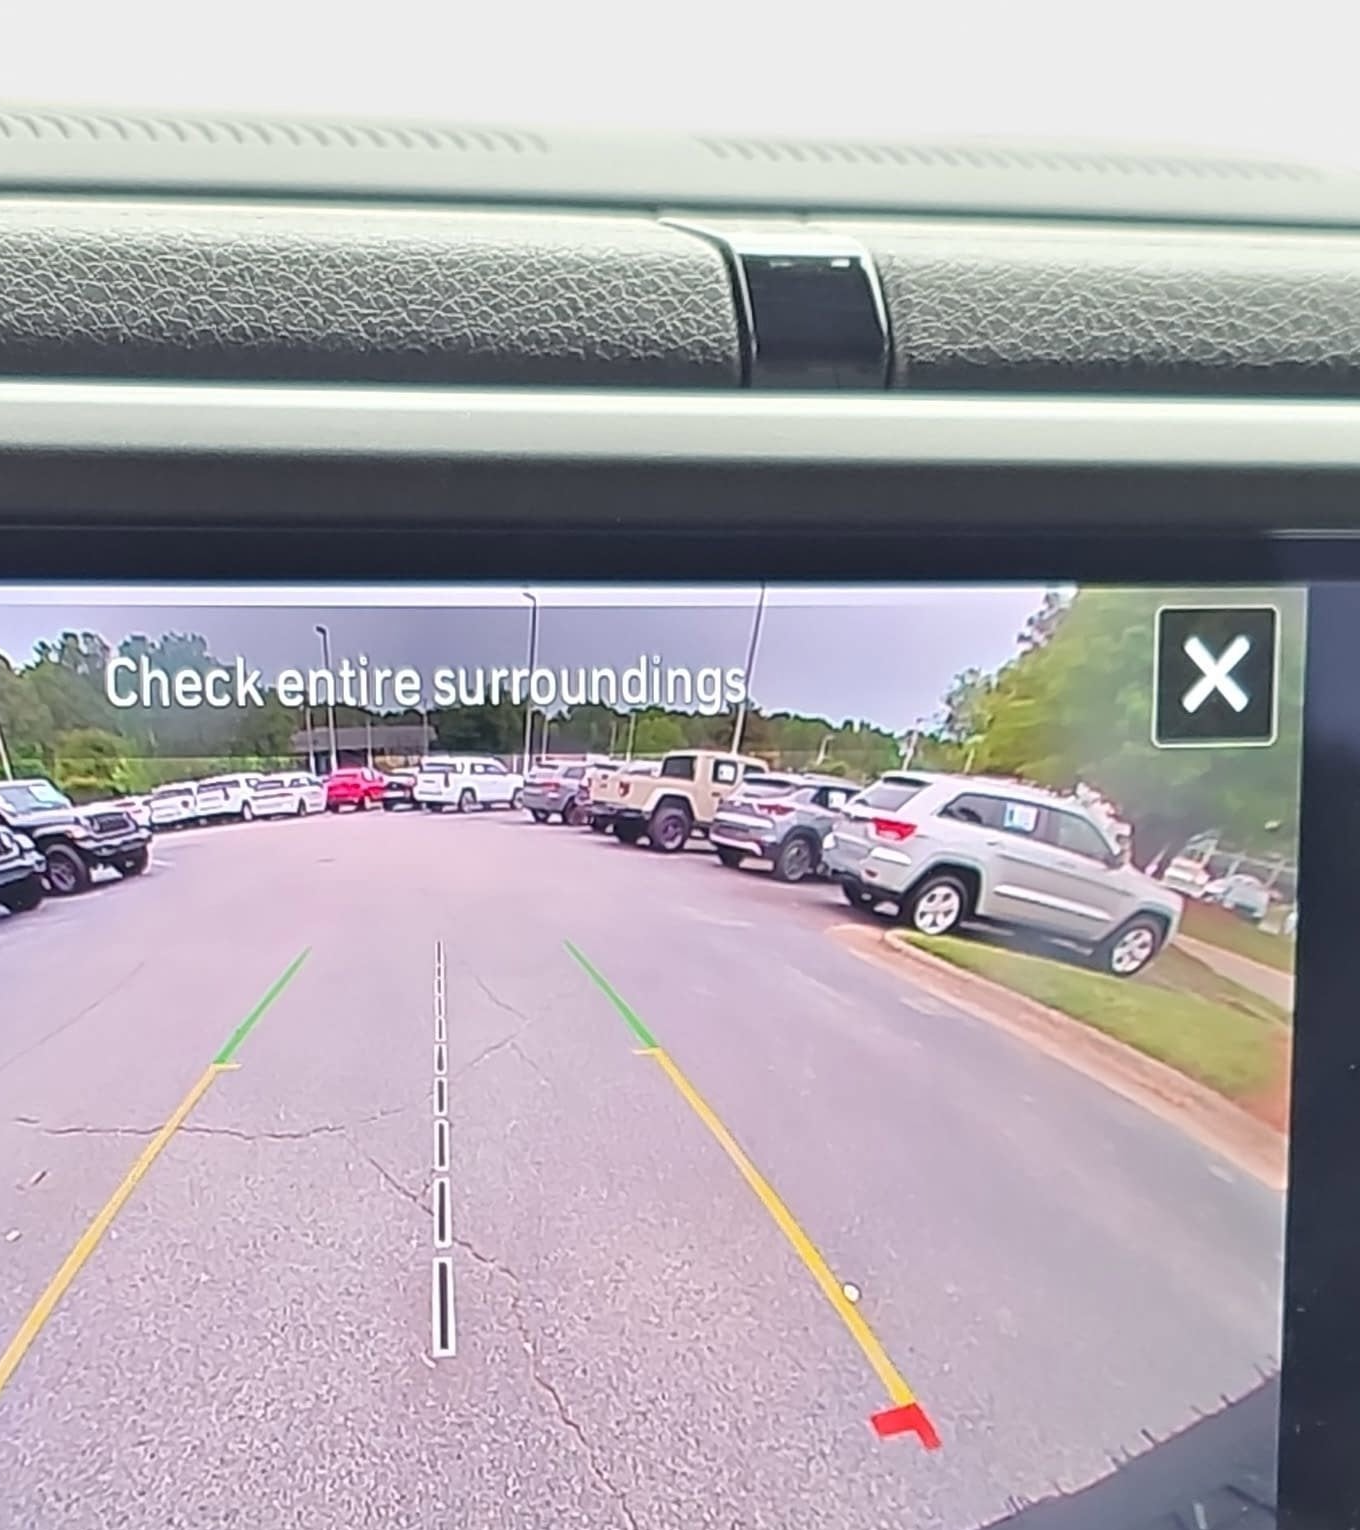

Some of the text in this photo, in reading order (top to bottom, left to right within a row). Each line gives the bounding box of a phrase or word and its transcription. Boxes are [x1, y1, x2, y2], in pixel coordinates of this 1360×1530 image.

[105, 654, 747, 716] Check entire surroundings
